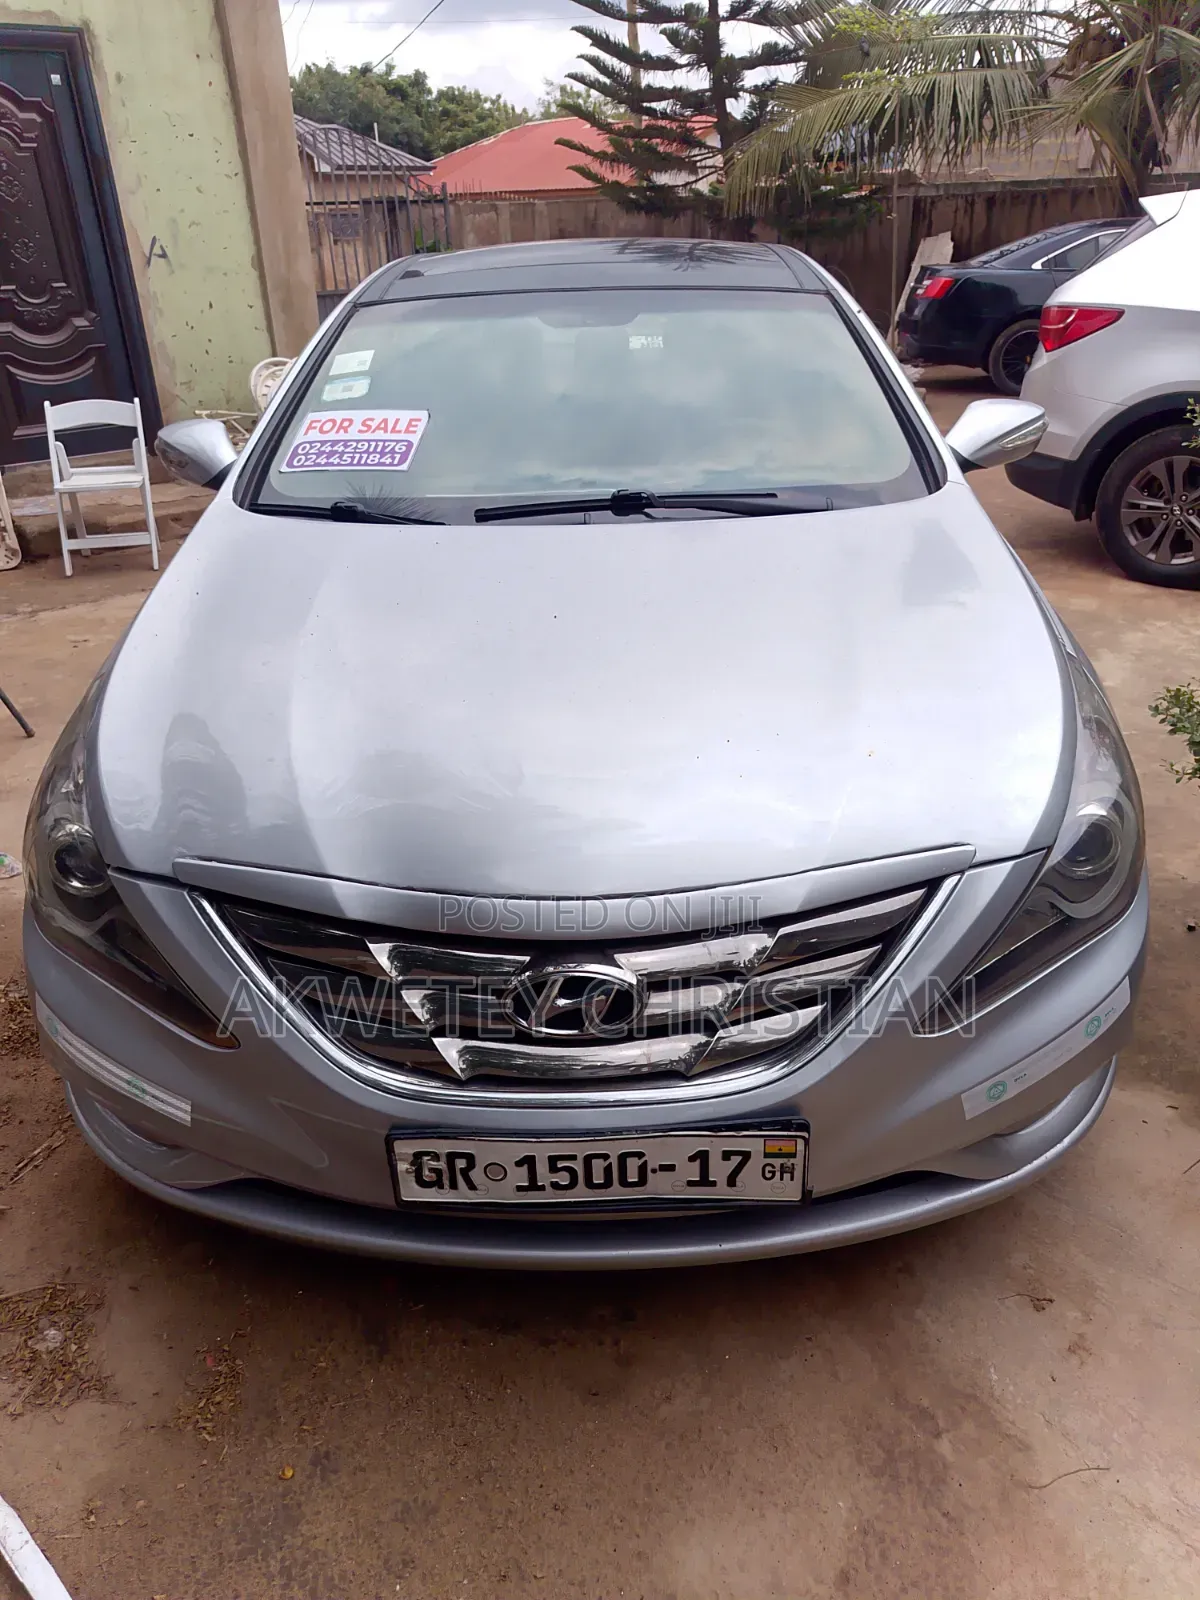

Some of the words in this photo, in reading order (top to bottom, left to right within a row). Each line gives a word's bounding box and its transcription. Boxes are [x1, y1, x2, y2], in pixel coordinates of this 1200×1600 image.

[304, 418, 354, 435] FOR
[358, 418, 421, 434] SALE
[297, 442, 408, 453] 0244291176
[293, 453, 401, 467] 0244511841
[412, 1150, 478, 1191] GR
[761, 1162, 795, 1182] GH
